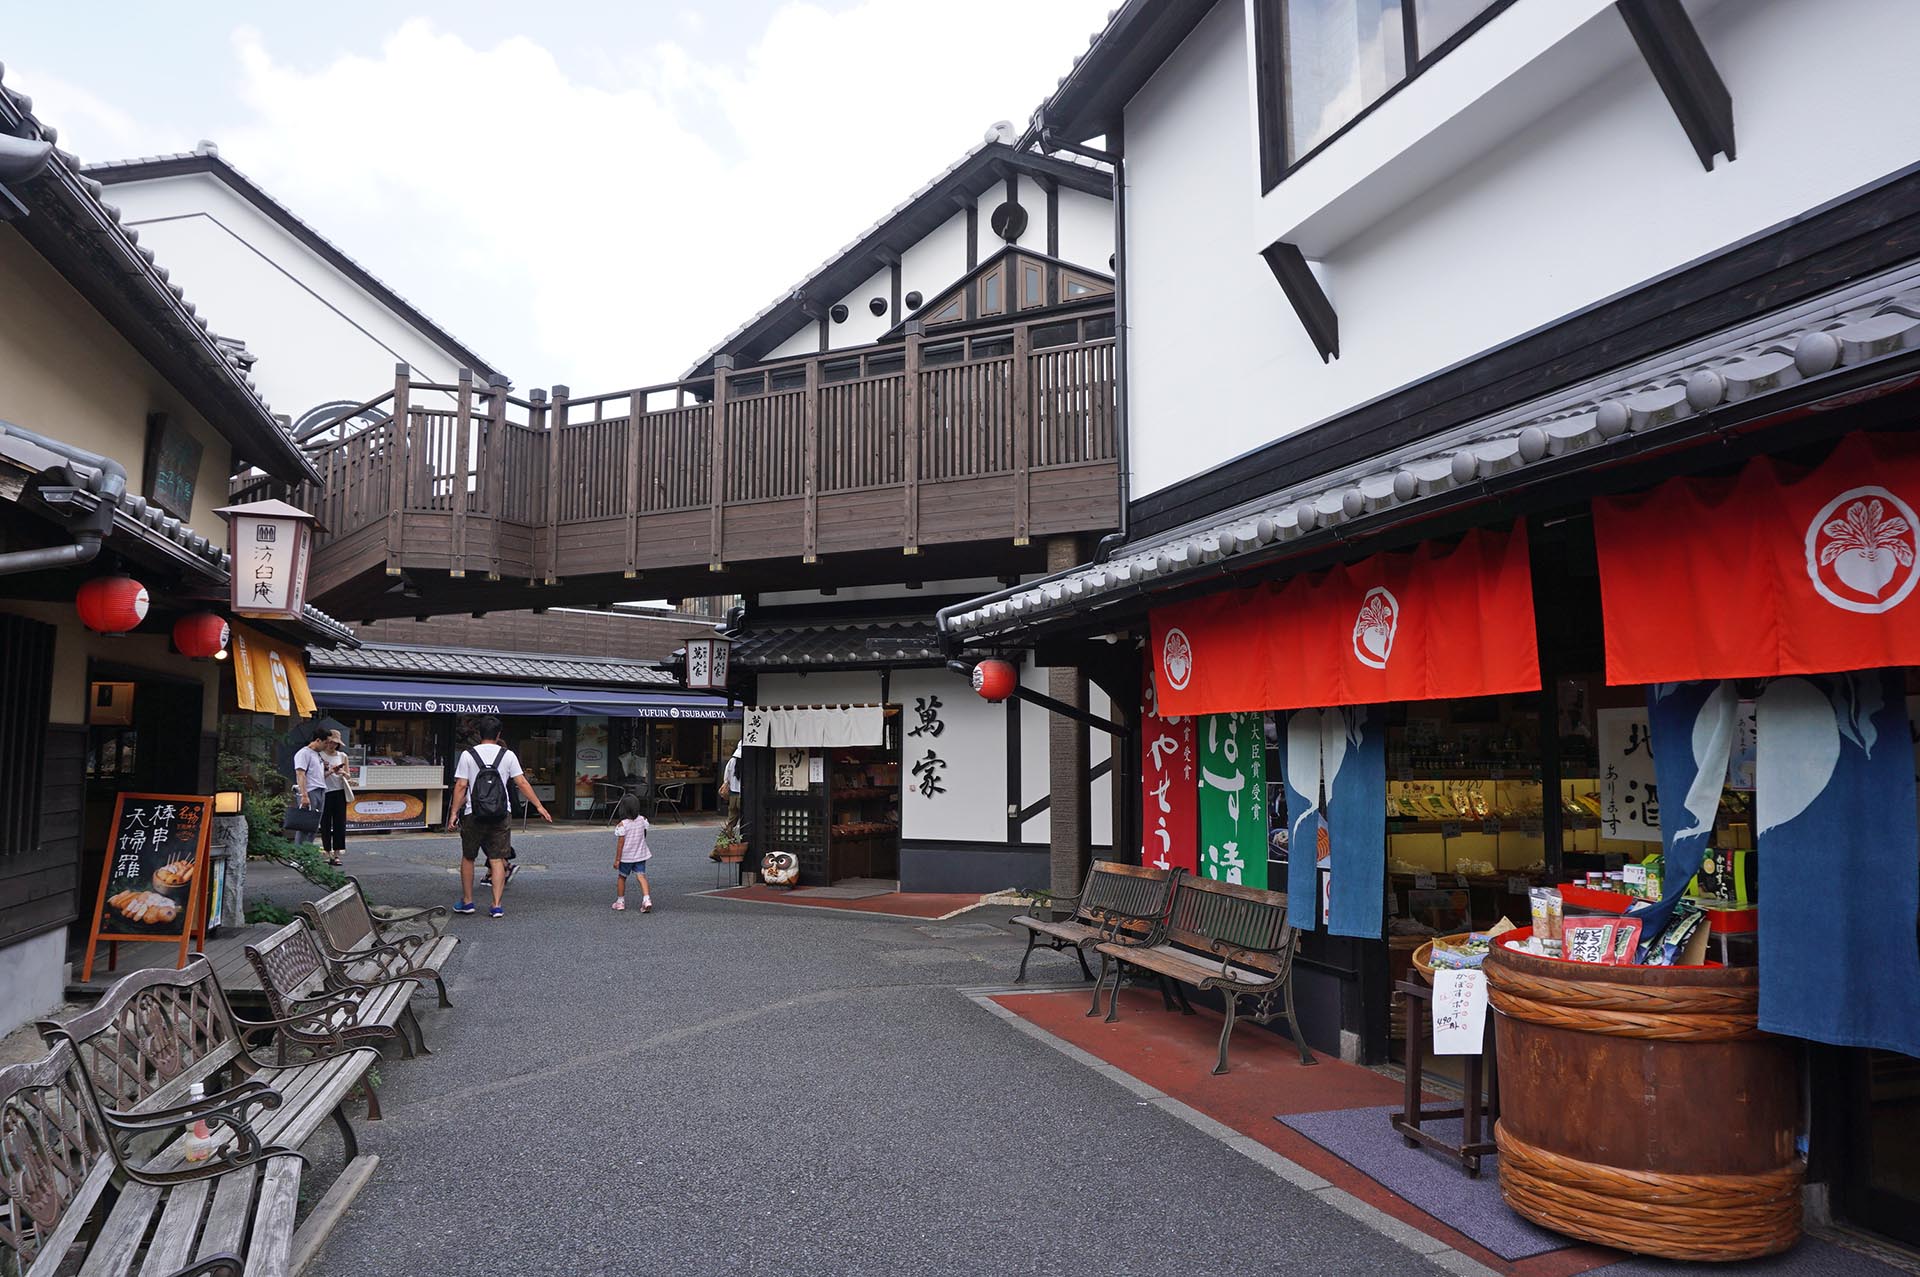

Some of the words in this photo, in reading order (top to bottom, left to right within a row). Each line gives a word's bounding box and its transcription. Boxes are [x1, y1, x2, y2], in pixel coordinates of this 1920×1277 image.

[692, 646, 703, 677] 萬家
[381, 701, 422, 711] YUFUIN
[439, 703, 500, 713] TSUBAMEYA
[638, 708, 669, 717] YUFUIN
[680, 709, 726, 718] TSUBAMEYA
[747, 715, 762, 743] 萬家
[907, 695, 947, 799] 萬家
[1602, 763, 1622, 836] あります
[114, 808, 150, 879] 天婦羅
[148, 804, 177, 852] 棒串
[1586, 929, 1602, 962] とうがら
